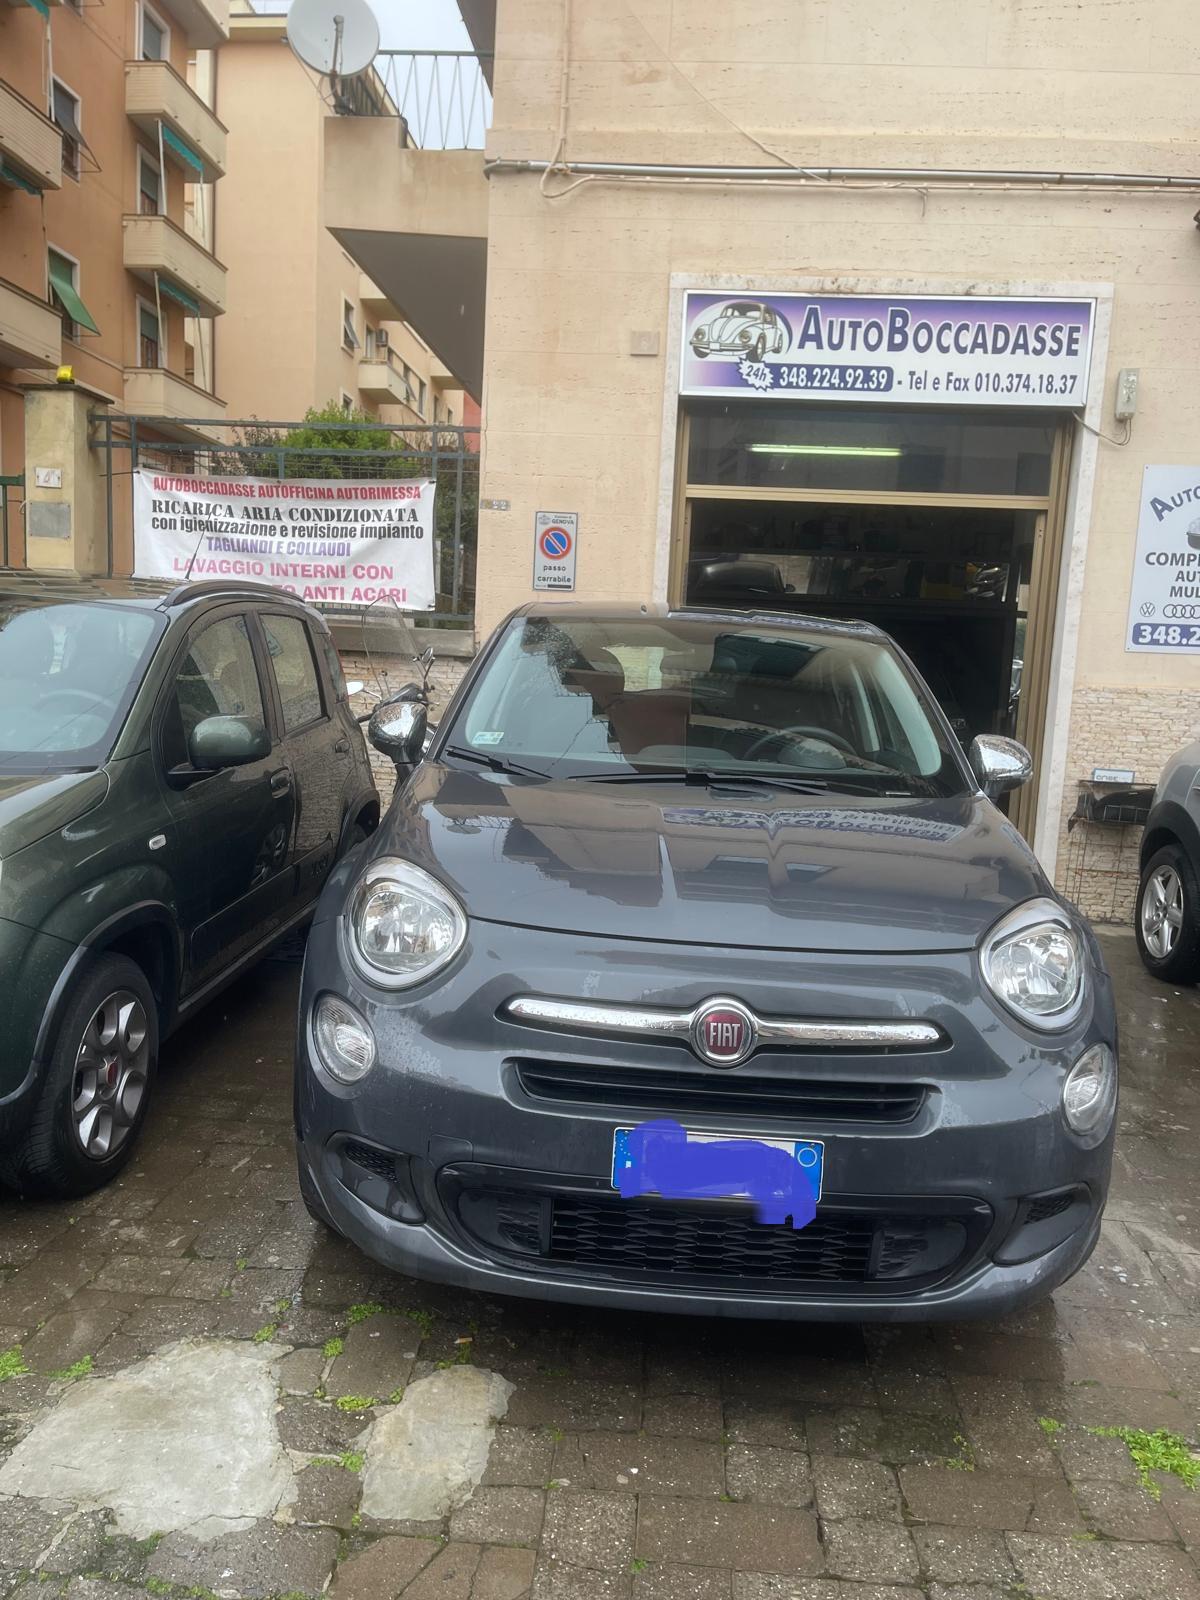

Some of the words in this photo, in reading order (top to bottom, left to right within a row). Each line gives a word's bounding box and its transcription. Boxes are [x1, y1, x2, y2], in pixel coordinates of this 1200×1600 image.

[745, 364, 767, 382] 24h
[779, 366, 888, 389] 348.224.92.39
[908, 370, 927, 390] Tel
[932, 376, 940, 391] e
[946, 371, 970, 392] Fax
[975, 372, 1078, 395] 010.374.18.37
[153, 477, 256, 498] AUTOBOCCADASSE
[258, 483, 335, 500] AUTOFFICINA
[336, 486, 421, 500] AUTORIMESSA
[152, 500, 235, 519] RICARICA
[240, 505, 283, 521] ARIA
[288, 508, 419, 523] CONDIZIONATA
[152, 517, 177, 531] con
[180, 516, 277, 537] igienizzazione
[279, 525, 288, 538] e
[291, 523, 357, 539] revisione
[360, 524, 424, 540] impianto
[206, 536, 273, 554] TAGLIANDI
[275, 541, 284, 555] E
[286, 541, 351, 557] COLLAUDI
[173, 558, 264, 576] LAVAGGIO
[270, 562, 346, 579] INTERNI
[352, 564, 394, 580] CON
[1145, 552, 1200, 567] COMP
[537, 575, 572, 583] carrabile
[1175, 570, 1200, 583] AU
[303, 585, 345, 601] ANTI
[351, 587, 407, 602] ACARI
[1138, 624, 1200, 646] 348.2
[709, 1022, 741, 1048] FIAT
